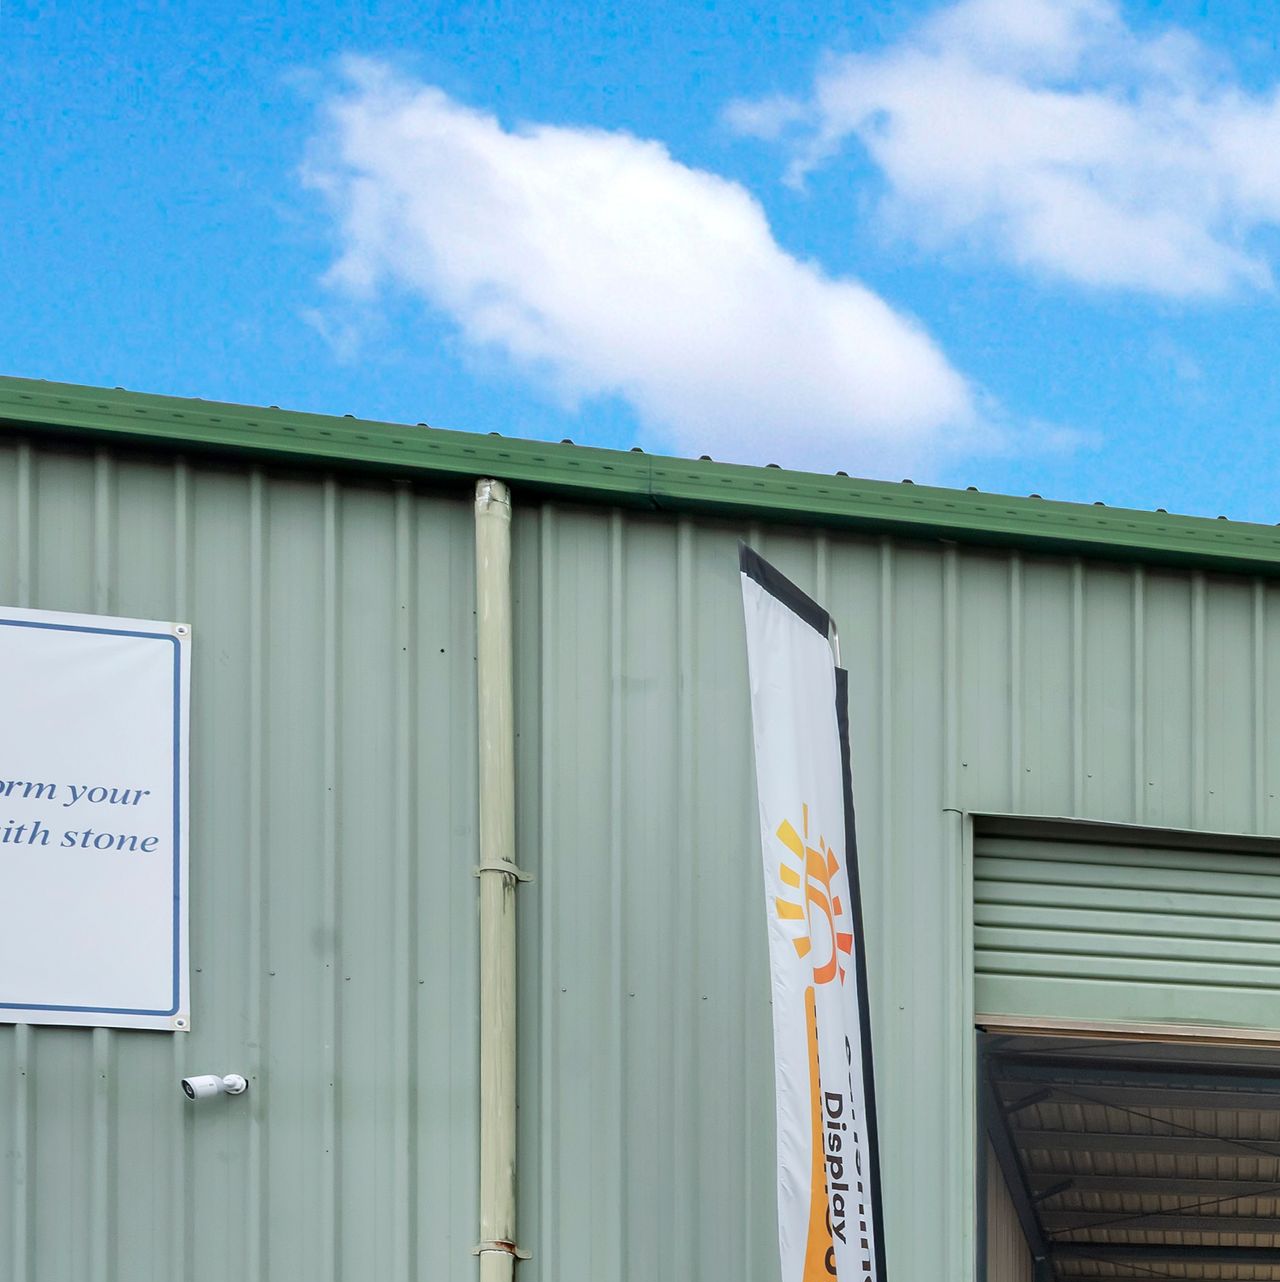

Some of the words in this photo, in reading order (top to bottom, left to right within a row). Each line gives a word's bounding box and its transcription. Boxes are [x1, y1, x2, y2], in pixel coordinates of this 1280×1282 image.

[62, 785, 151, 807] your
[0, 820, 51, 846] ith
[60, 828, 160, 853] stone
[824, 1091, 850, 1245] Display
